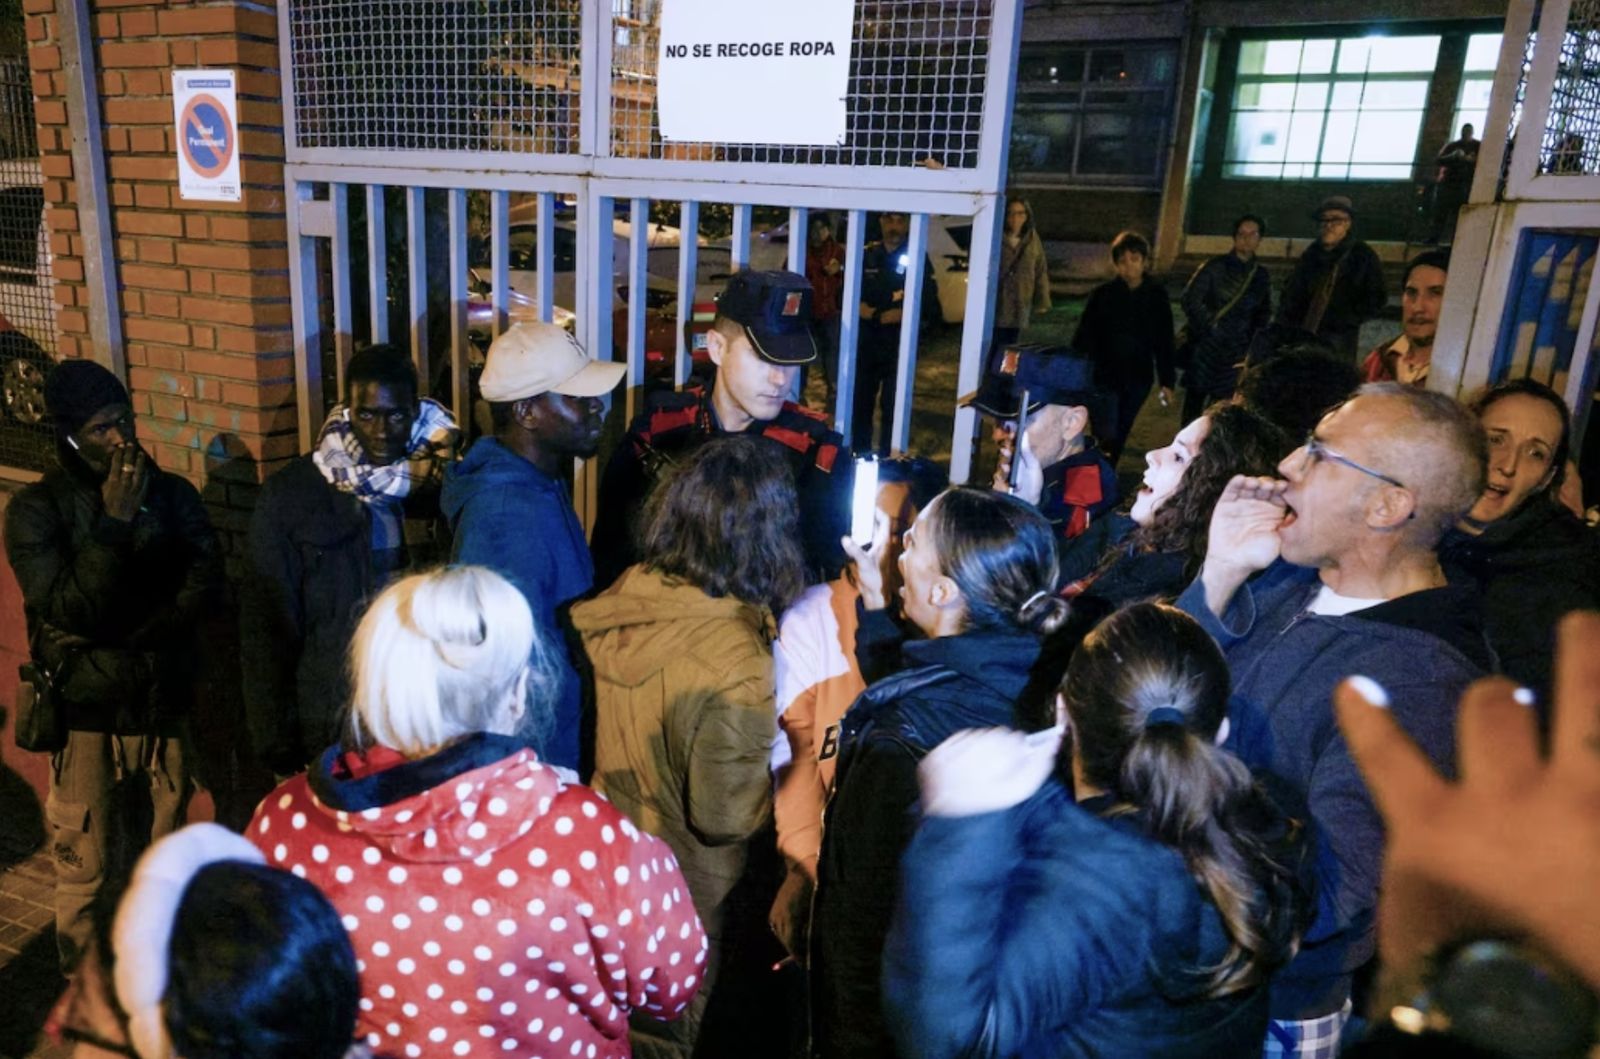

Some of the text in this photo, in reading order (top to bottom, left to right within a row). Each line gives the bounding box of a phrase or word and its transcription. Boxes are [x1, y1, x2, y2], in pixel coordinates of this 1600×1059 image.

[666, 41, 836, 58] NO SE RECOGE ROPA
